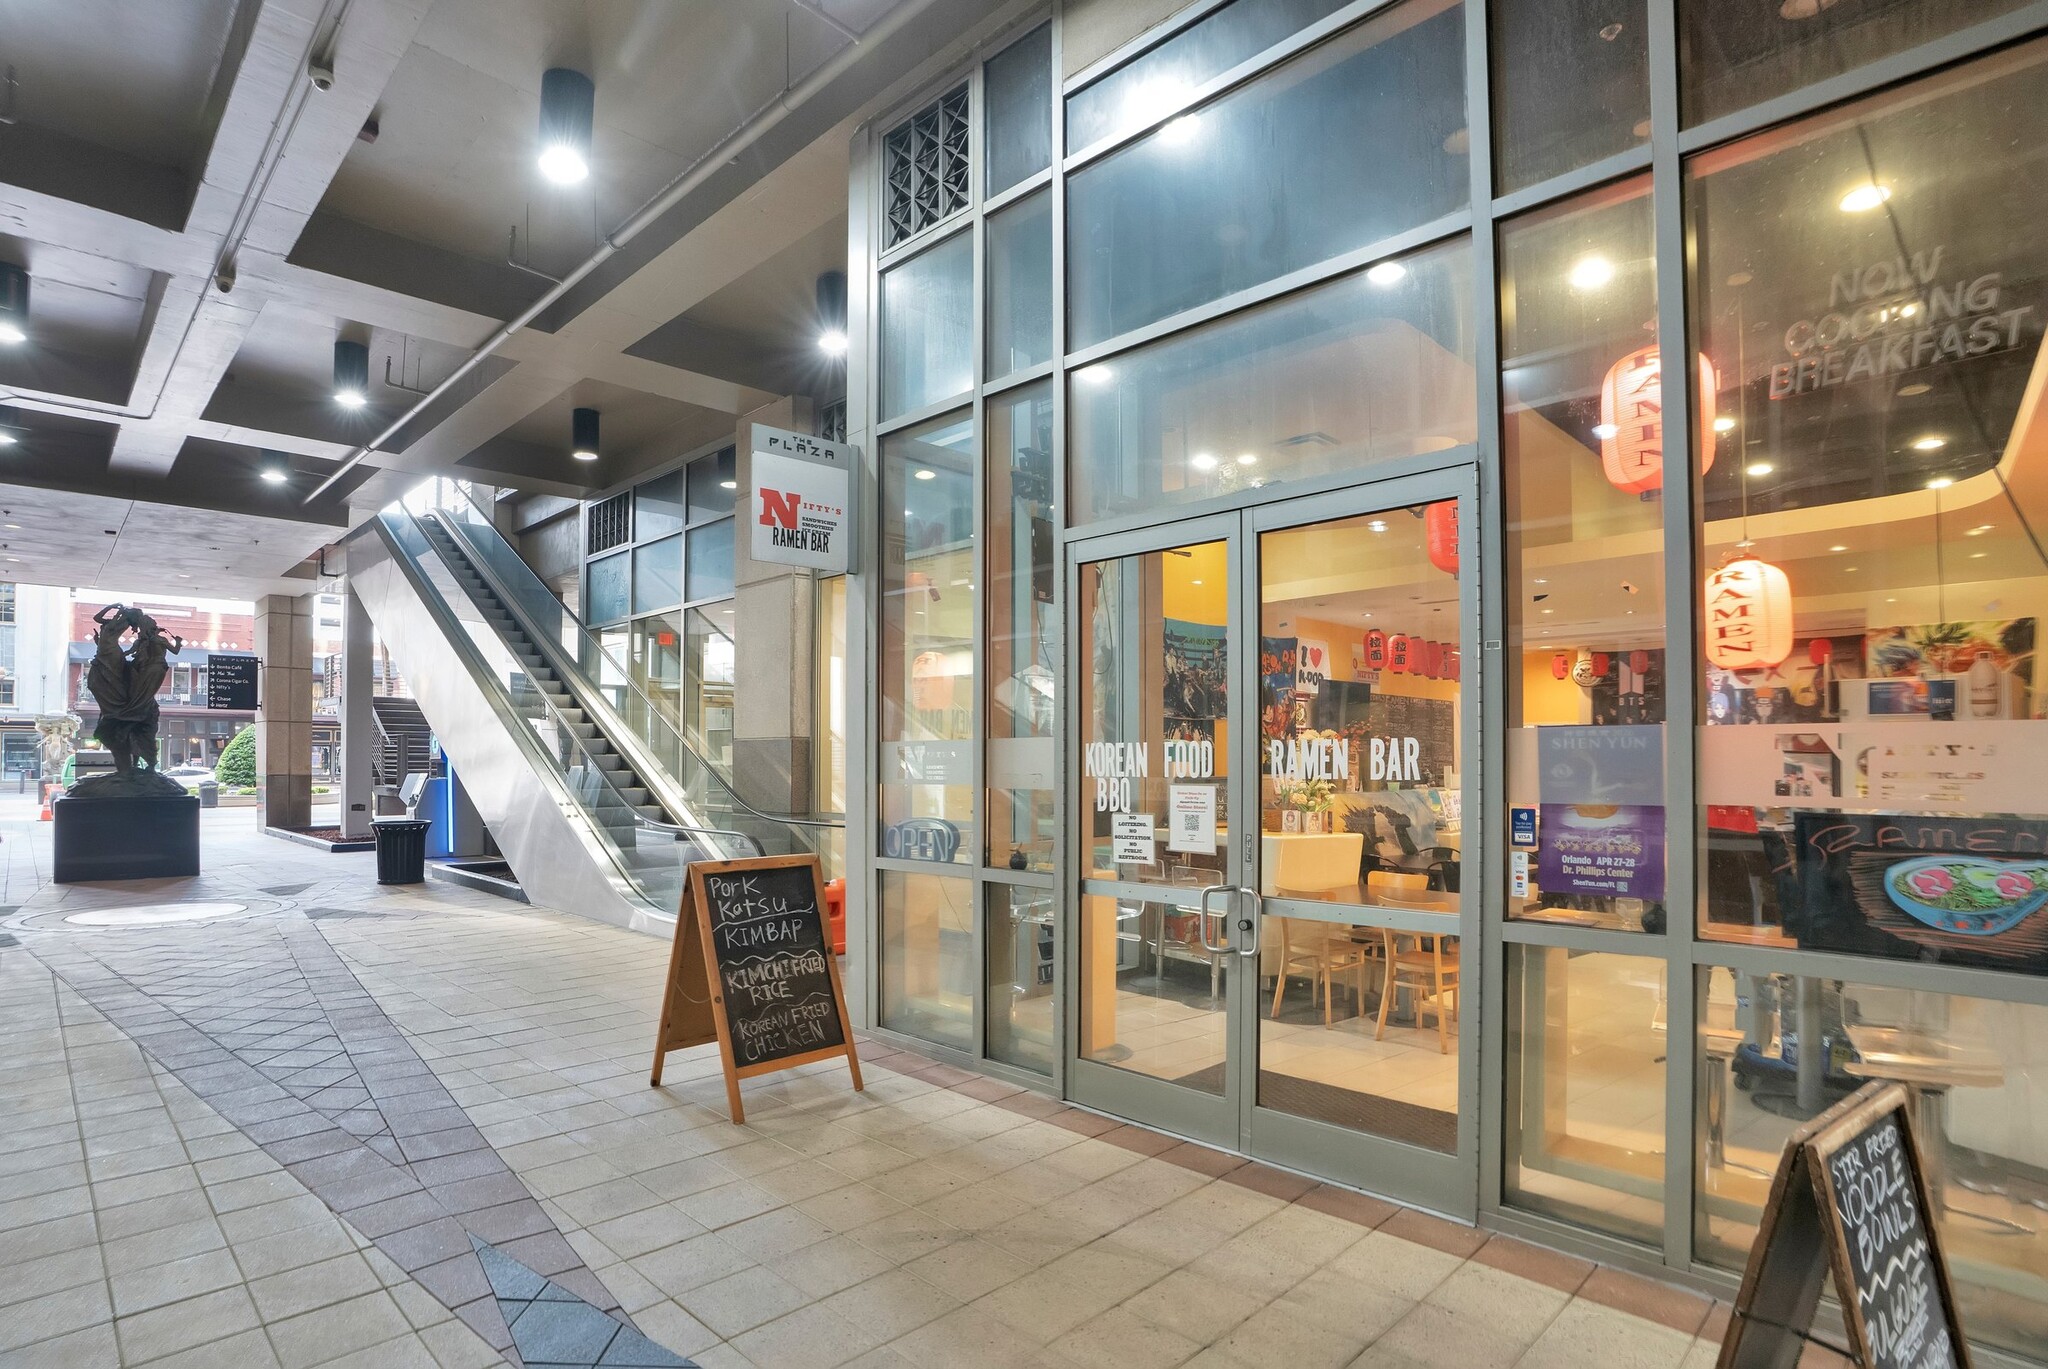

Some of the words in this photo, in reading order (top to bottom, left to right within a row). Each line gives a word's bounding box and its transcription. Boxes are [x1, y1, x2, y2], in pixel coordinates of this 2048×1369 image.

[1830, 245, 1945, 307] NOW
[1770, 306, 2033, 400] BREAKFAST
[769, 437, 835, 460] PLAZA
[793, 436, 813, 445] THE
[773, 526, 807, 551] RAMEN
[811, 533, 829, 553] BAR
[802, 516, 838, 527] SANDWICHES
[1711, 569, 1753, 658] RAMEN
[1618, 697, 1645, 706] BTS
[1085, 742, 1148, 778] KOREAN
[1163, 740, 1213, 779] FOOD
[1271, 738, 1348, 780] RAMEN
[1370, 737, 1421, 781] BAR
[1551, 737, 1601, 749] SHEN
[1608, 737, 1647, 749] YUN
[1097, 777, 1132, 813] BBQ
[886, 826, 949, 862] OPEN
[1562, 854, 1591, 865] Orlando
[1597, 856, 1612, 866] APR
[1613, 857, 1635, 867] 27-28
[1563, 865, 1574, 875] Dr.
[1575, 865, 1605, 877] Phillips
[1607, 868, 1634, 878] Center
[725, 919, 803, 949] KIMBAP
[727, 961, 793, 994] KIMCHI
[792, 955, 826, 977] FRIED
[751, 980, 794, 1006] RICE
[738, 1012, 788, 1041] KOREAN
[791, 1001, 831, 1025] FRIED
[745, 1020, 826, 1061] CHICKEN
[1832, 1147, 1864, 1189] STIR
[1865, 1125, 1897, 1163] FRIED
[1857, 1187, 1916, 1273] BOWLS
